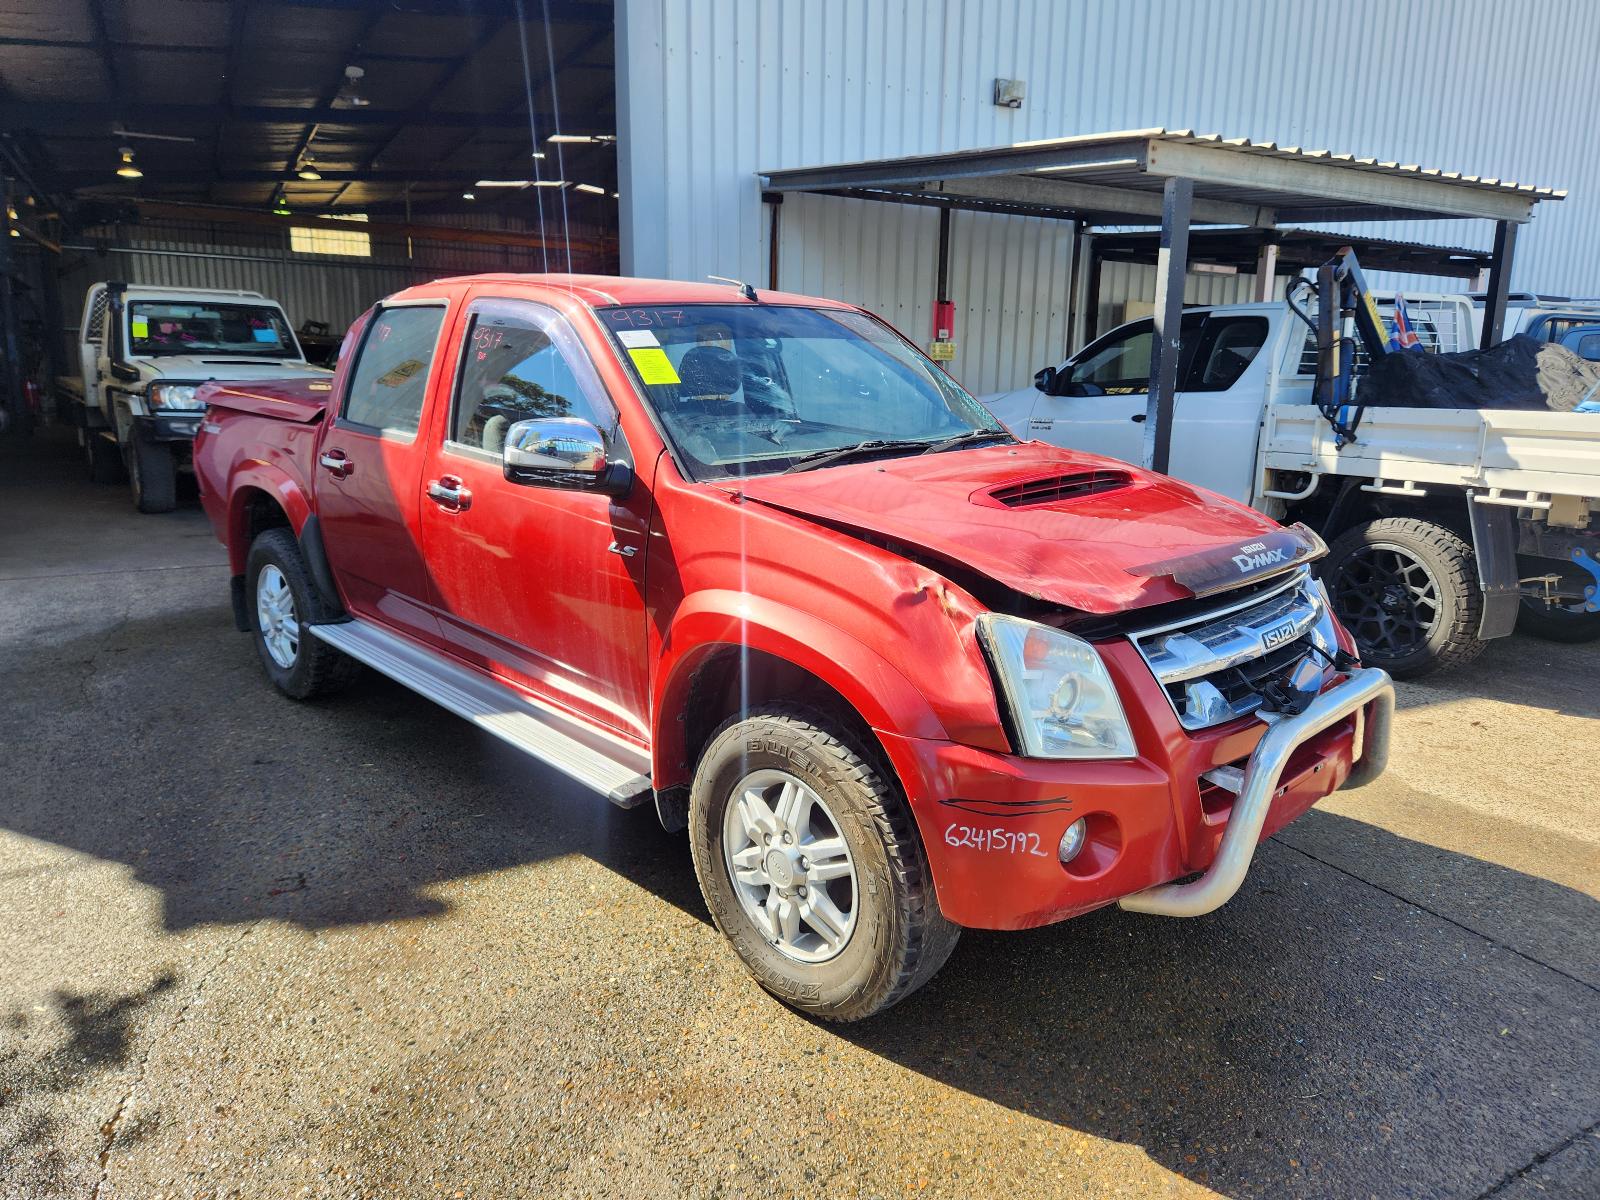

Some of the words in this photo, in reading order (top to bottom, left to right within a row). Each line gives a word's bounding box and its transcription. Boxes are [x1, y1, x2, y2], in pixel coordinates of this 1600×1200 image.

[611, 309, 683, 327] 9317
[473, 327, 503, 350] 9317
[607, 541, 638, 557] LS
[1240, 542, 1267, 555] ISUZU
[1262, 620, 1297, 649] ISUZU
[944, 823, 1048, 857] 62415792
